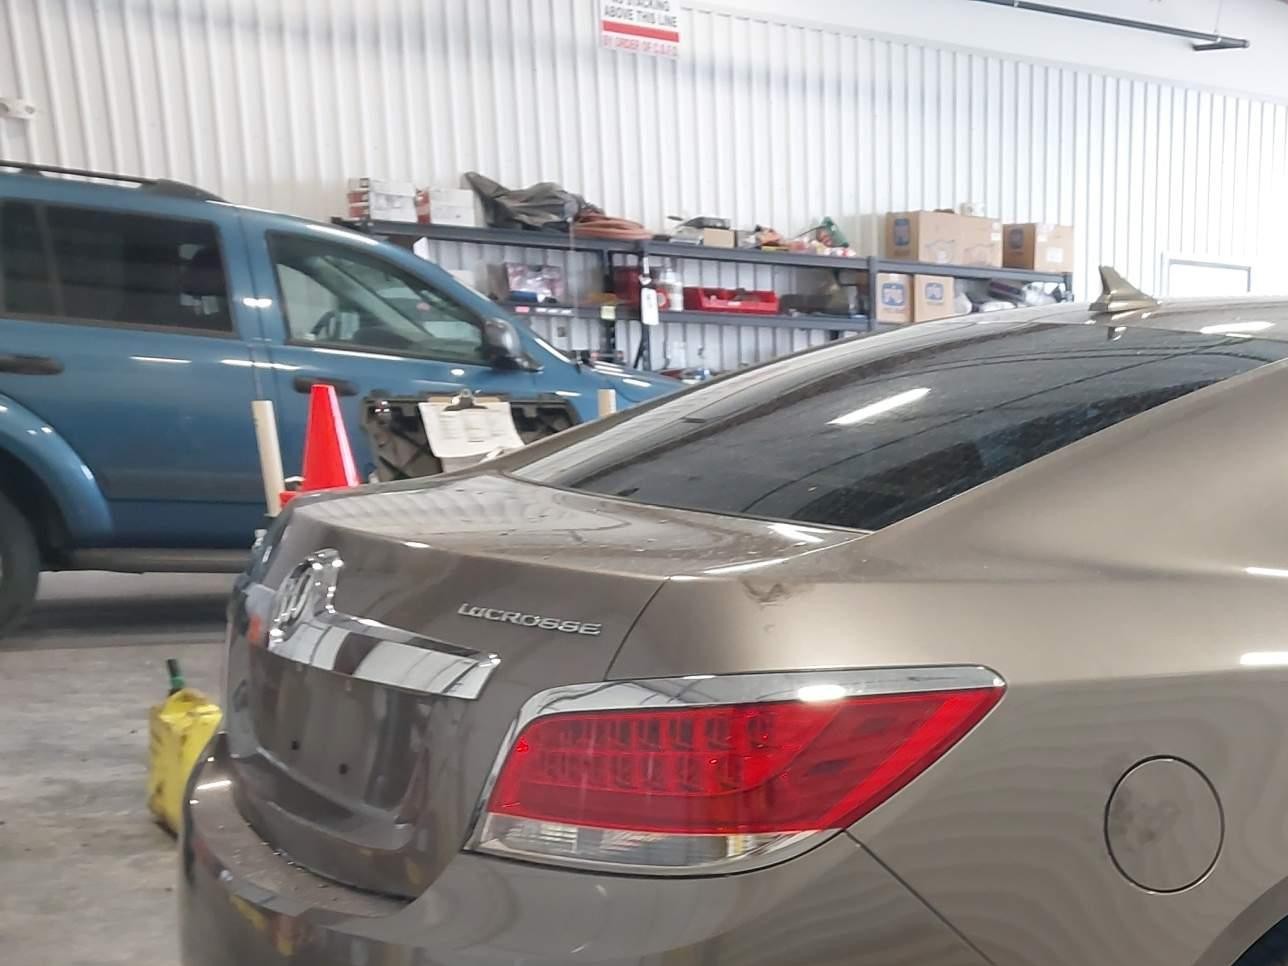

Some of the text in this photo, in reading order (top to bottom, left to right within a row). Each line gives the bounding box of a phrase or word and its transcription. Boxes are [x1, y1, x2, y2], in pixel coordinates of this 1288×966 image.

[605, 5, 678, 28] ABOVE THIS LINE
